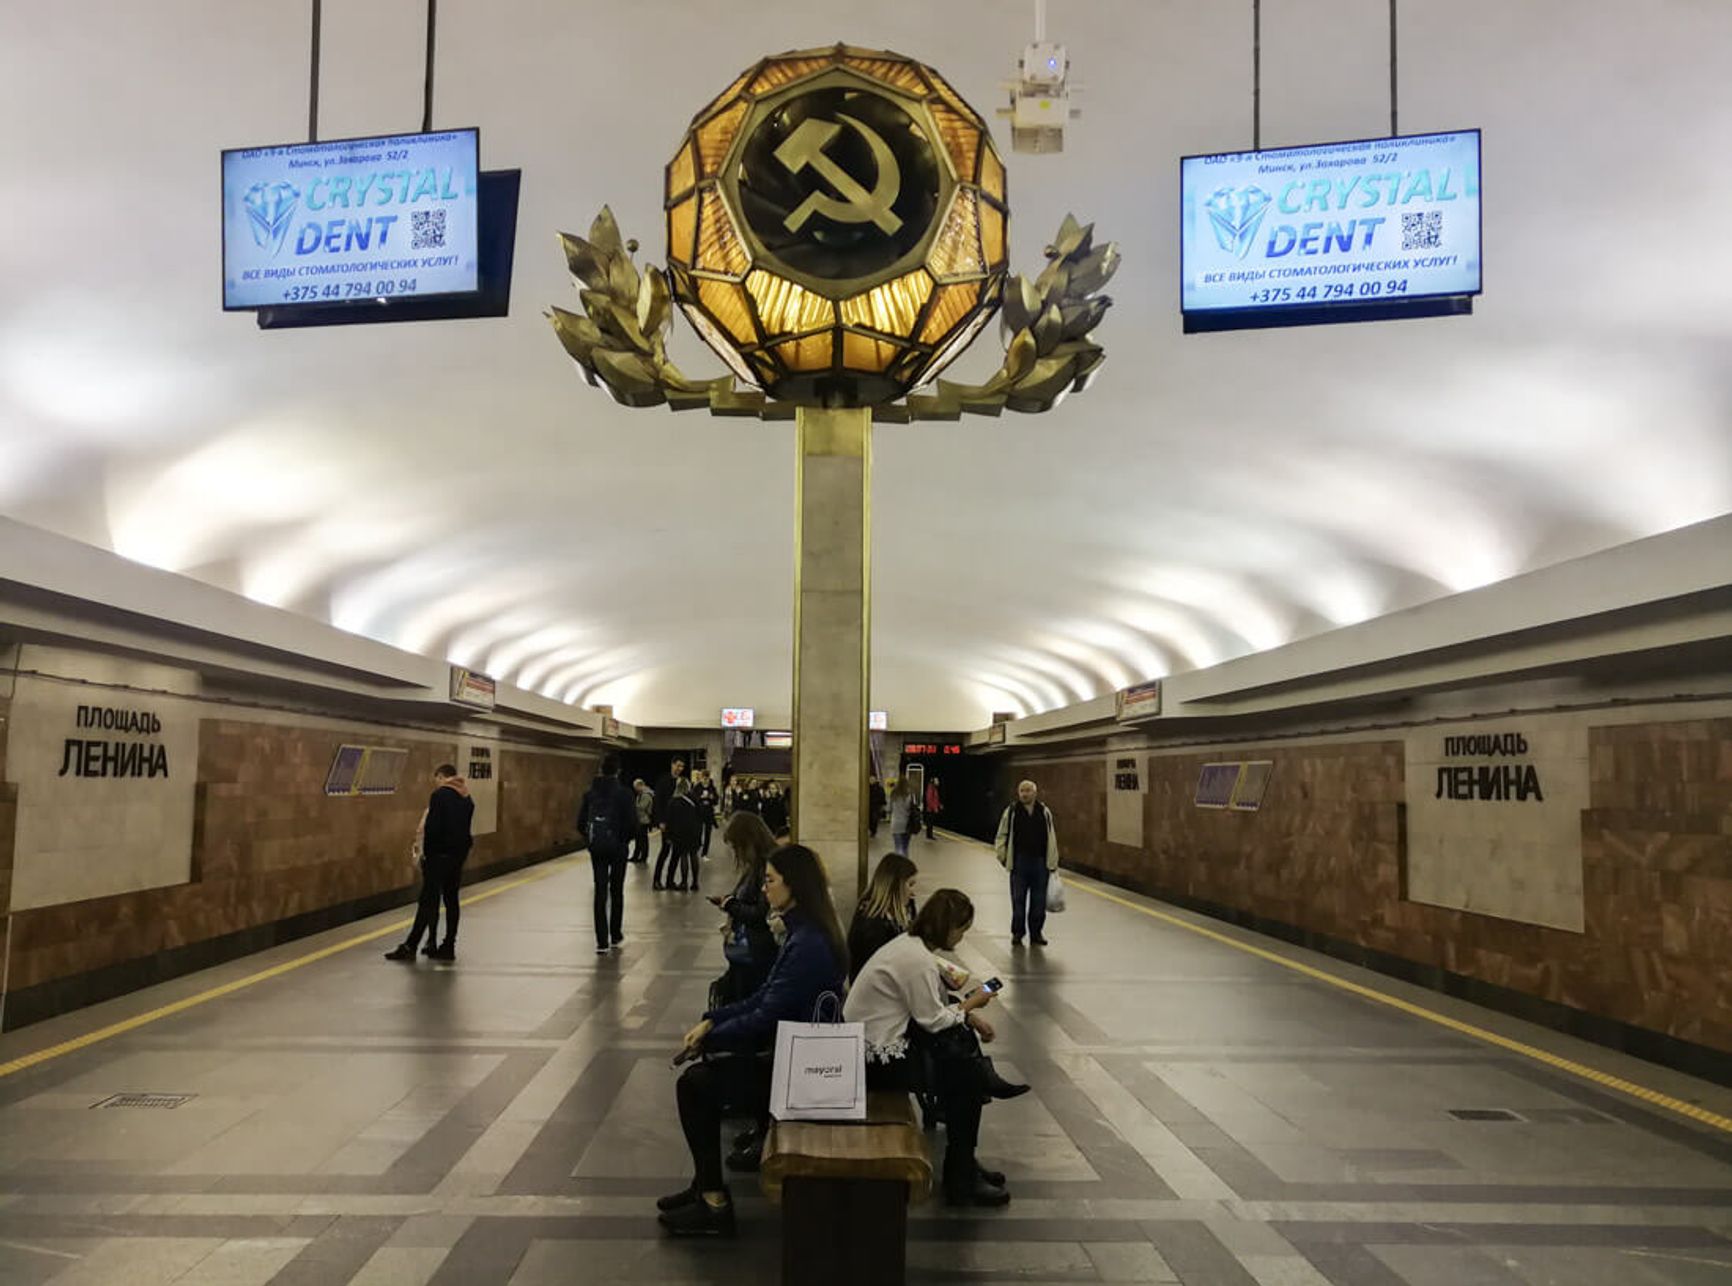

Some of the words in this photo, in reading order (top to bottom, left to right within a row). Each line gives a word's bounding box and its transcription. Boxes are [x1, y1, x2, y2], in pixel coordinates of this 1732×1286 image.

[387, 149, 409, 161] 52/2
[1372, 152, 1398, 164] 52/2
[305, 167, 459, 212] CRYSTAL
[1277, 167, 1457, 215] CRYSTAL
[295, 215, 398, 256] DENT
[1266, 217, 1386, 258] DENT
[242, 269, 261, 281] ВСЕ
[263, 267, 296, 280] ВИДЫ
[298, 259, 418, 277] СТОМАТОЛОГИЧЕСКИХ
[1204, 272, 1225, 284] ВСЕ
[1228, 270, 1265, 284] ВИДЫ
[1268, 259, 1409, 280] СТОМАТОЛОГИЧЕСКИХ
[283, 285, 318, 301] +375
[322, 283, 340, 298] 44
[345, 281, 371, 297] 794
[376, 279, 395, 295] 00
[399, 278, 417, 293] 94
[1250, 287, 1290, 303] +375
[1296, 285, 1317, 300] 44
[1323, 283, 1354, 298] 794
[1359, 281, 1381, 296] 00
[1386, 278, 1408, 294] 94
[76, 705, 161, 735] ПЛОЩАДЬ
[1444, 733, 1528, 756] ПЛОЩАДЬ
[58, 739, 168, 778] ЛЕНИНА
[1435, 765, 1544, 802] ЛЕНИНА
